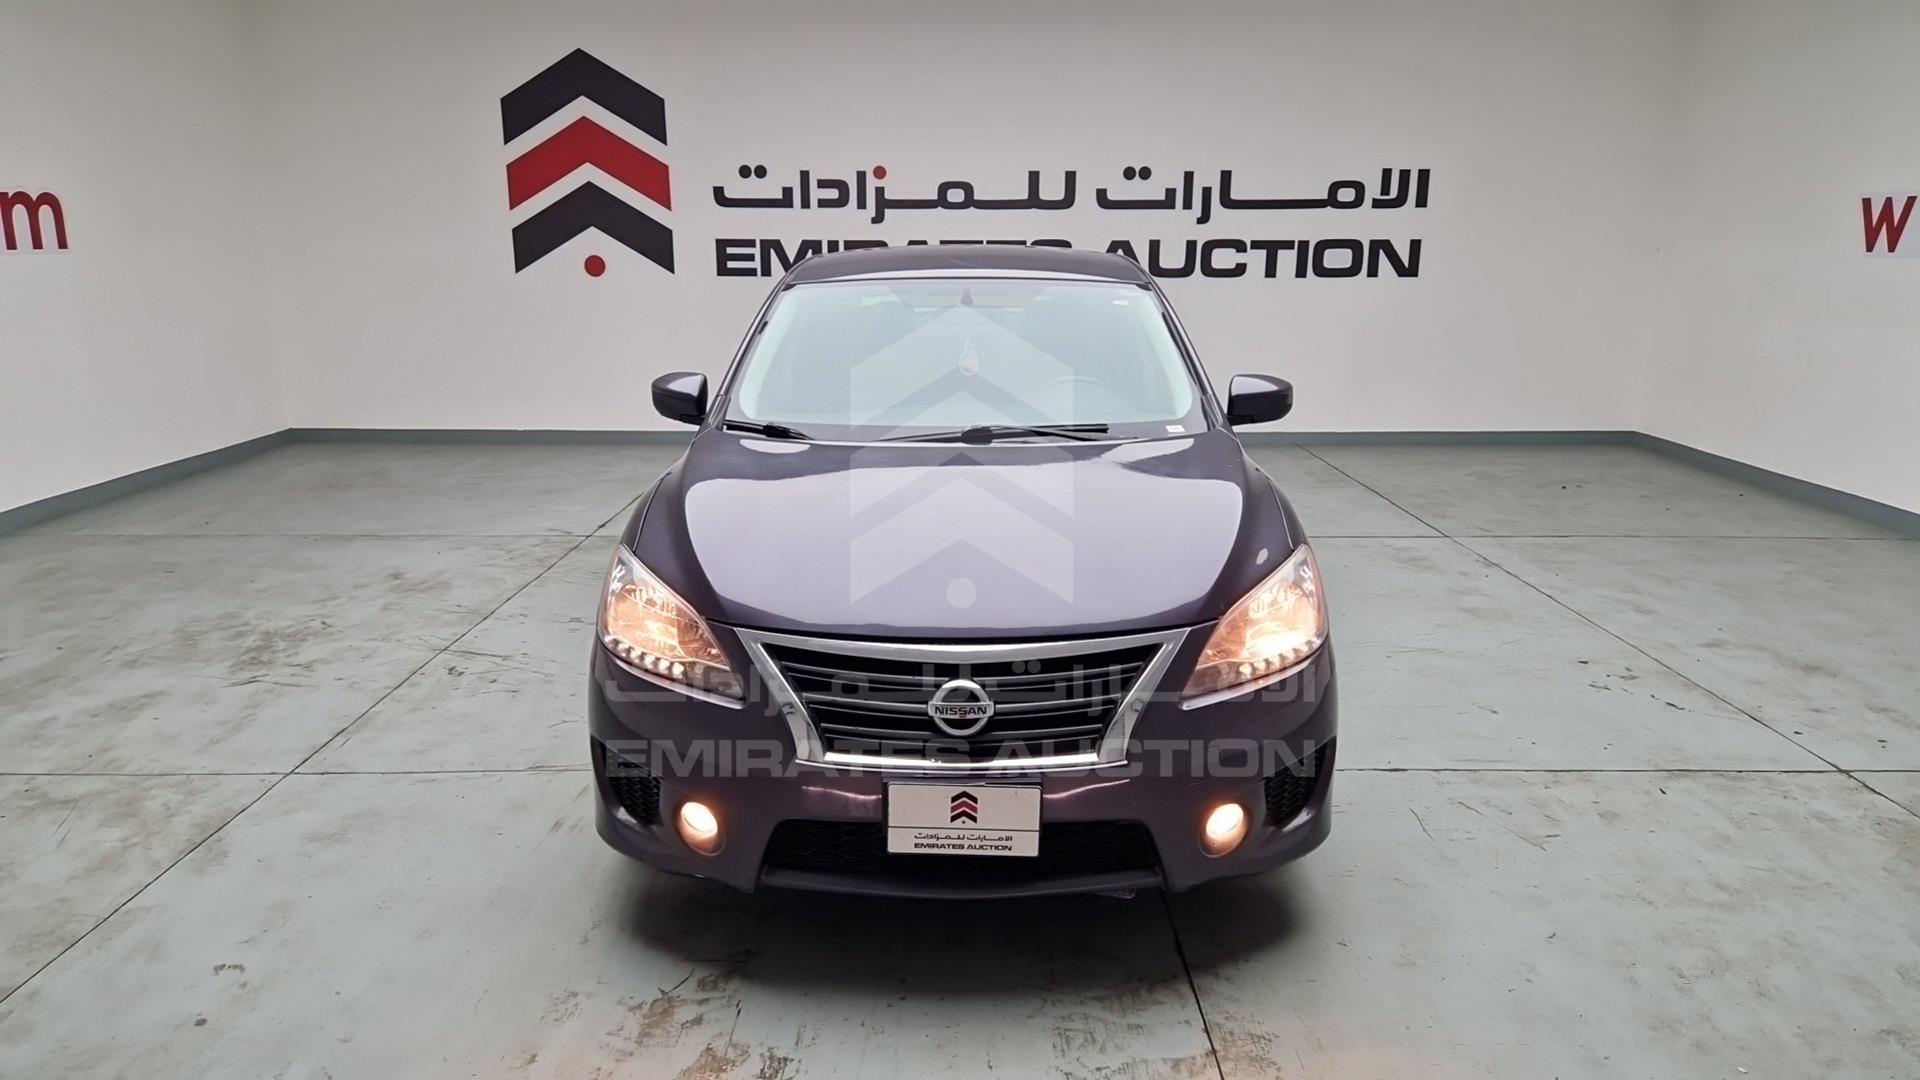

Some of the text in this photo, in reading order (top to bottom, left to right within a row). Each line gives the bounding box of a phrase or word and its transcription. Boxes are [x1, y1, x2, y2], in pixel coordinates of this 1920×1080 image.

[934, 706, 987, 716] NISSAN
[914, 842, 1012, 851] EMIRATES AUCTION
